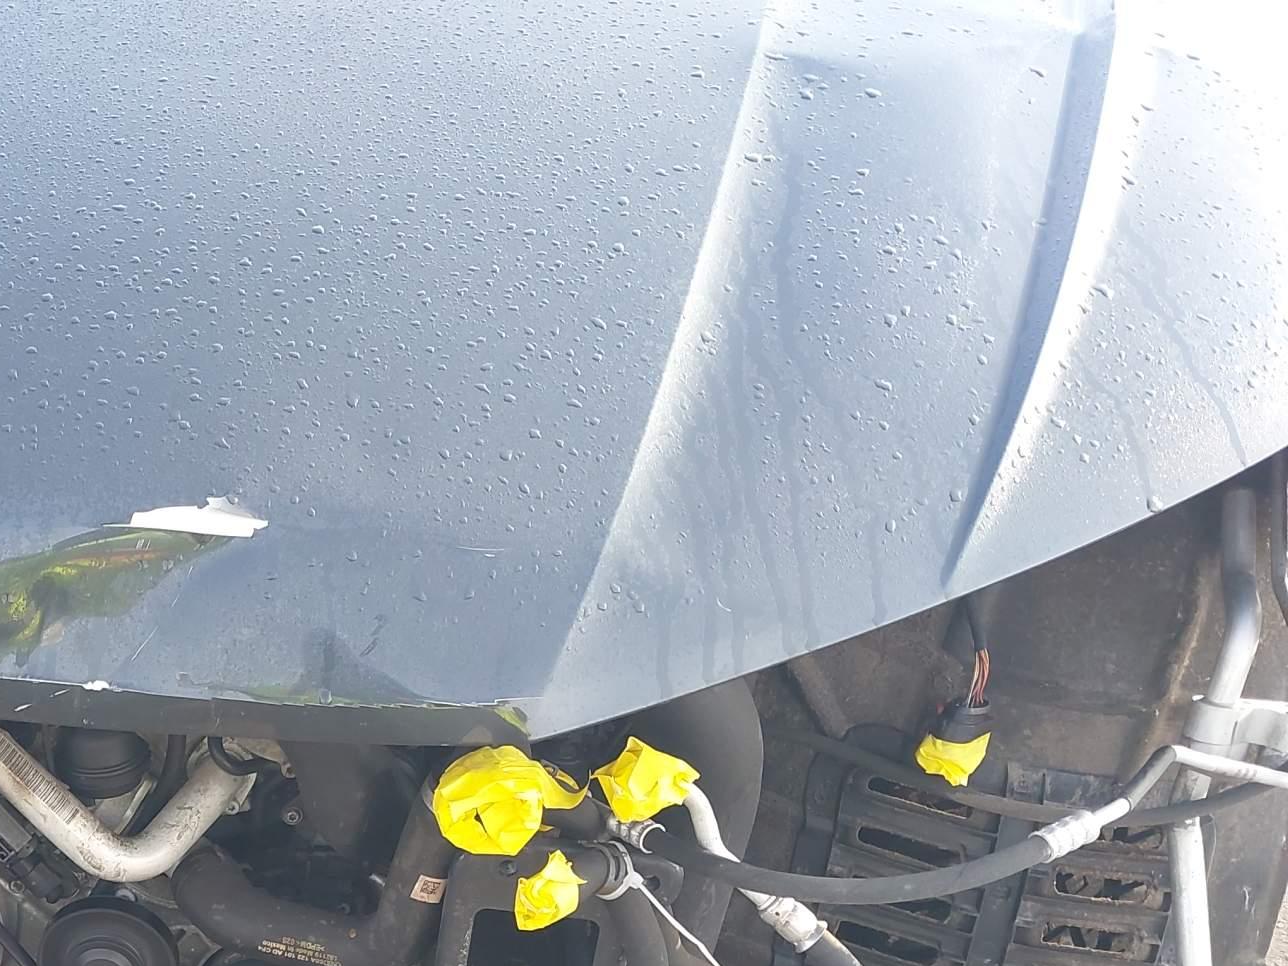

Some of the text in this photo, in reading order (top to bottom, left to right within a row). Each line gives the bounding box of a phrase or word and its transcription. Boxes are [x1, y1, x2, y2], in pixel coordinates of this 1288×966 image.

[262, 940, 286, 951] Mexico
[272, 948, 283, 956] AD
[295, 947, 314, 957] Made
